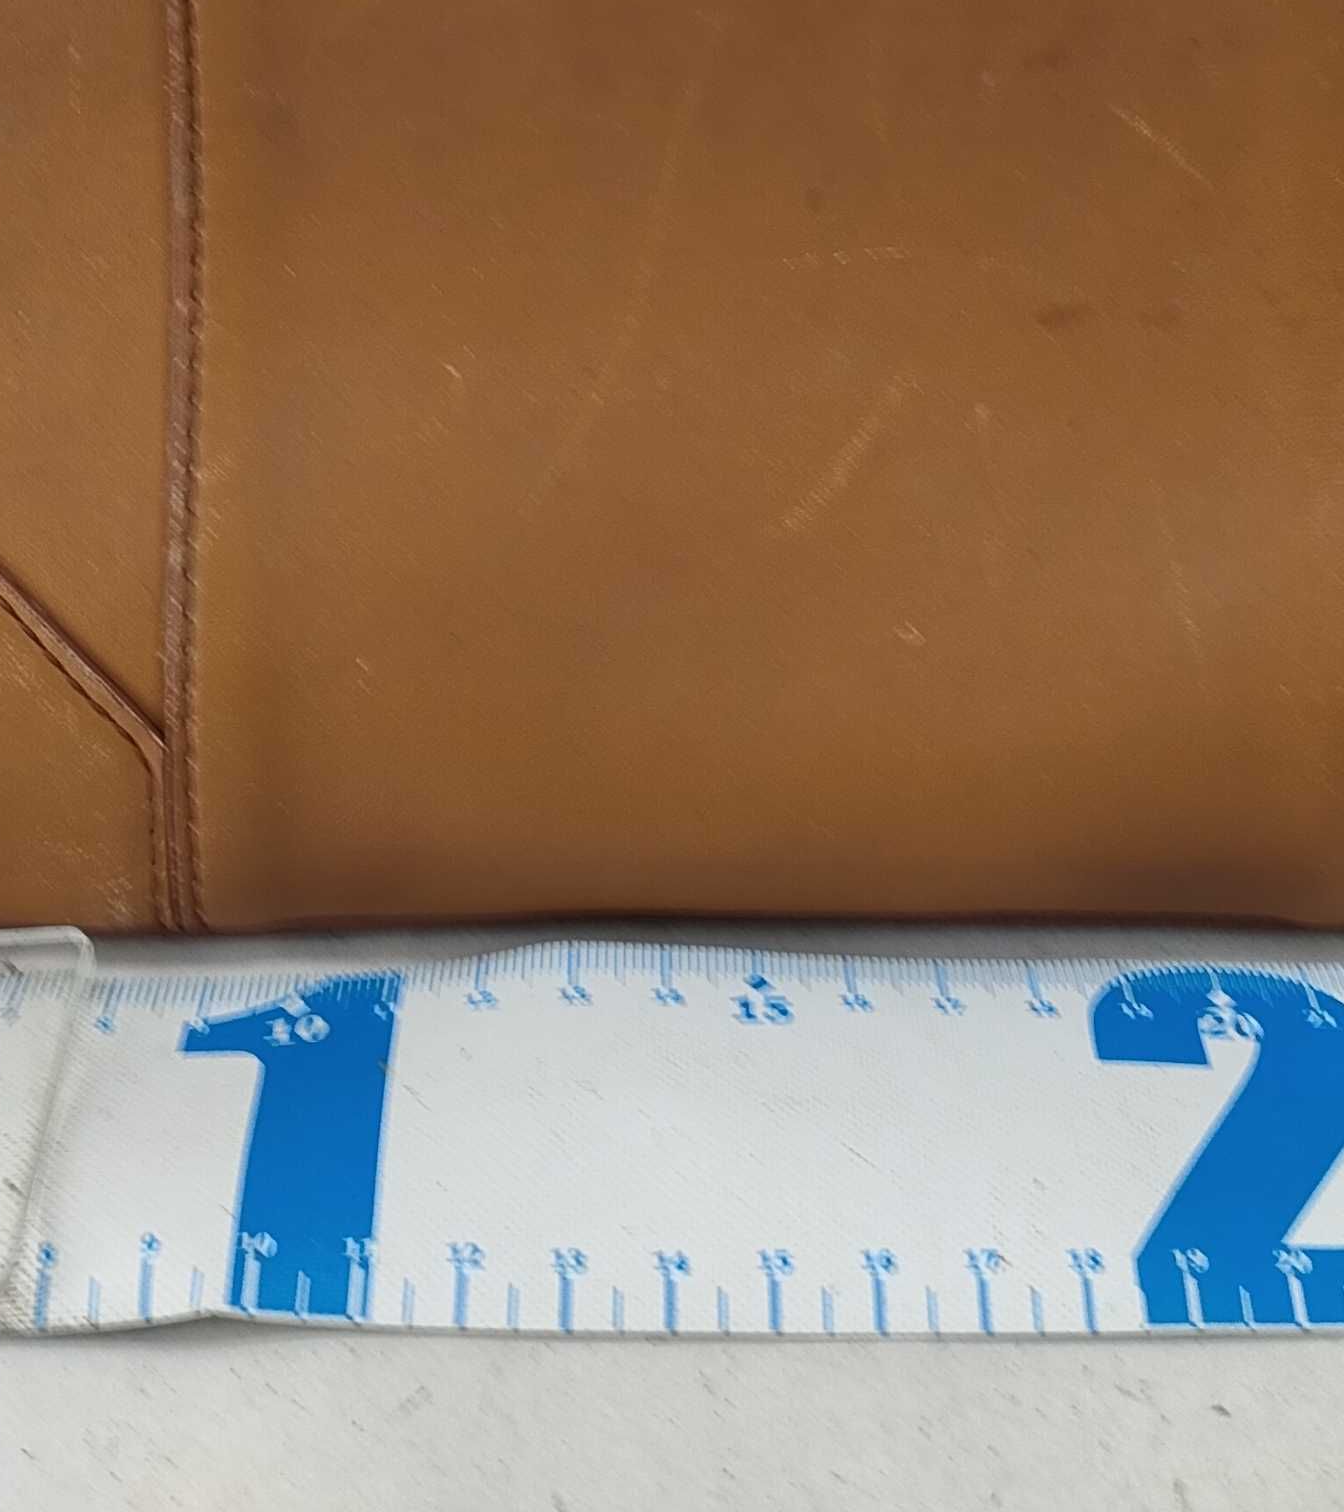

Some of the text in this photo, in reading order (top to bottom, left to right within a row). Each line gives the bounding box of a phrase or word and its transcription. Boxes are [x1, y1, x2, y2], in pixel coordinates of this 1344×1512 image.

[263, 1014, 330, 1049] 10
[730, 995, 795, 1024] 15
[1196, 1006, 1264, 1041] 20
[178, 972, 403, 1319] 1
[447, 1241, 486, 1270] 12
